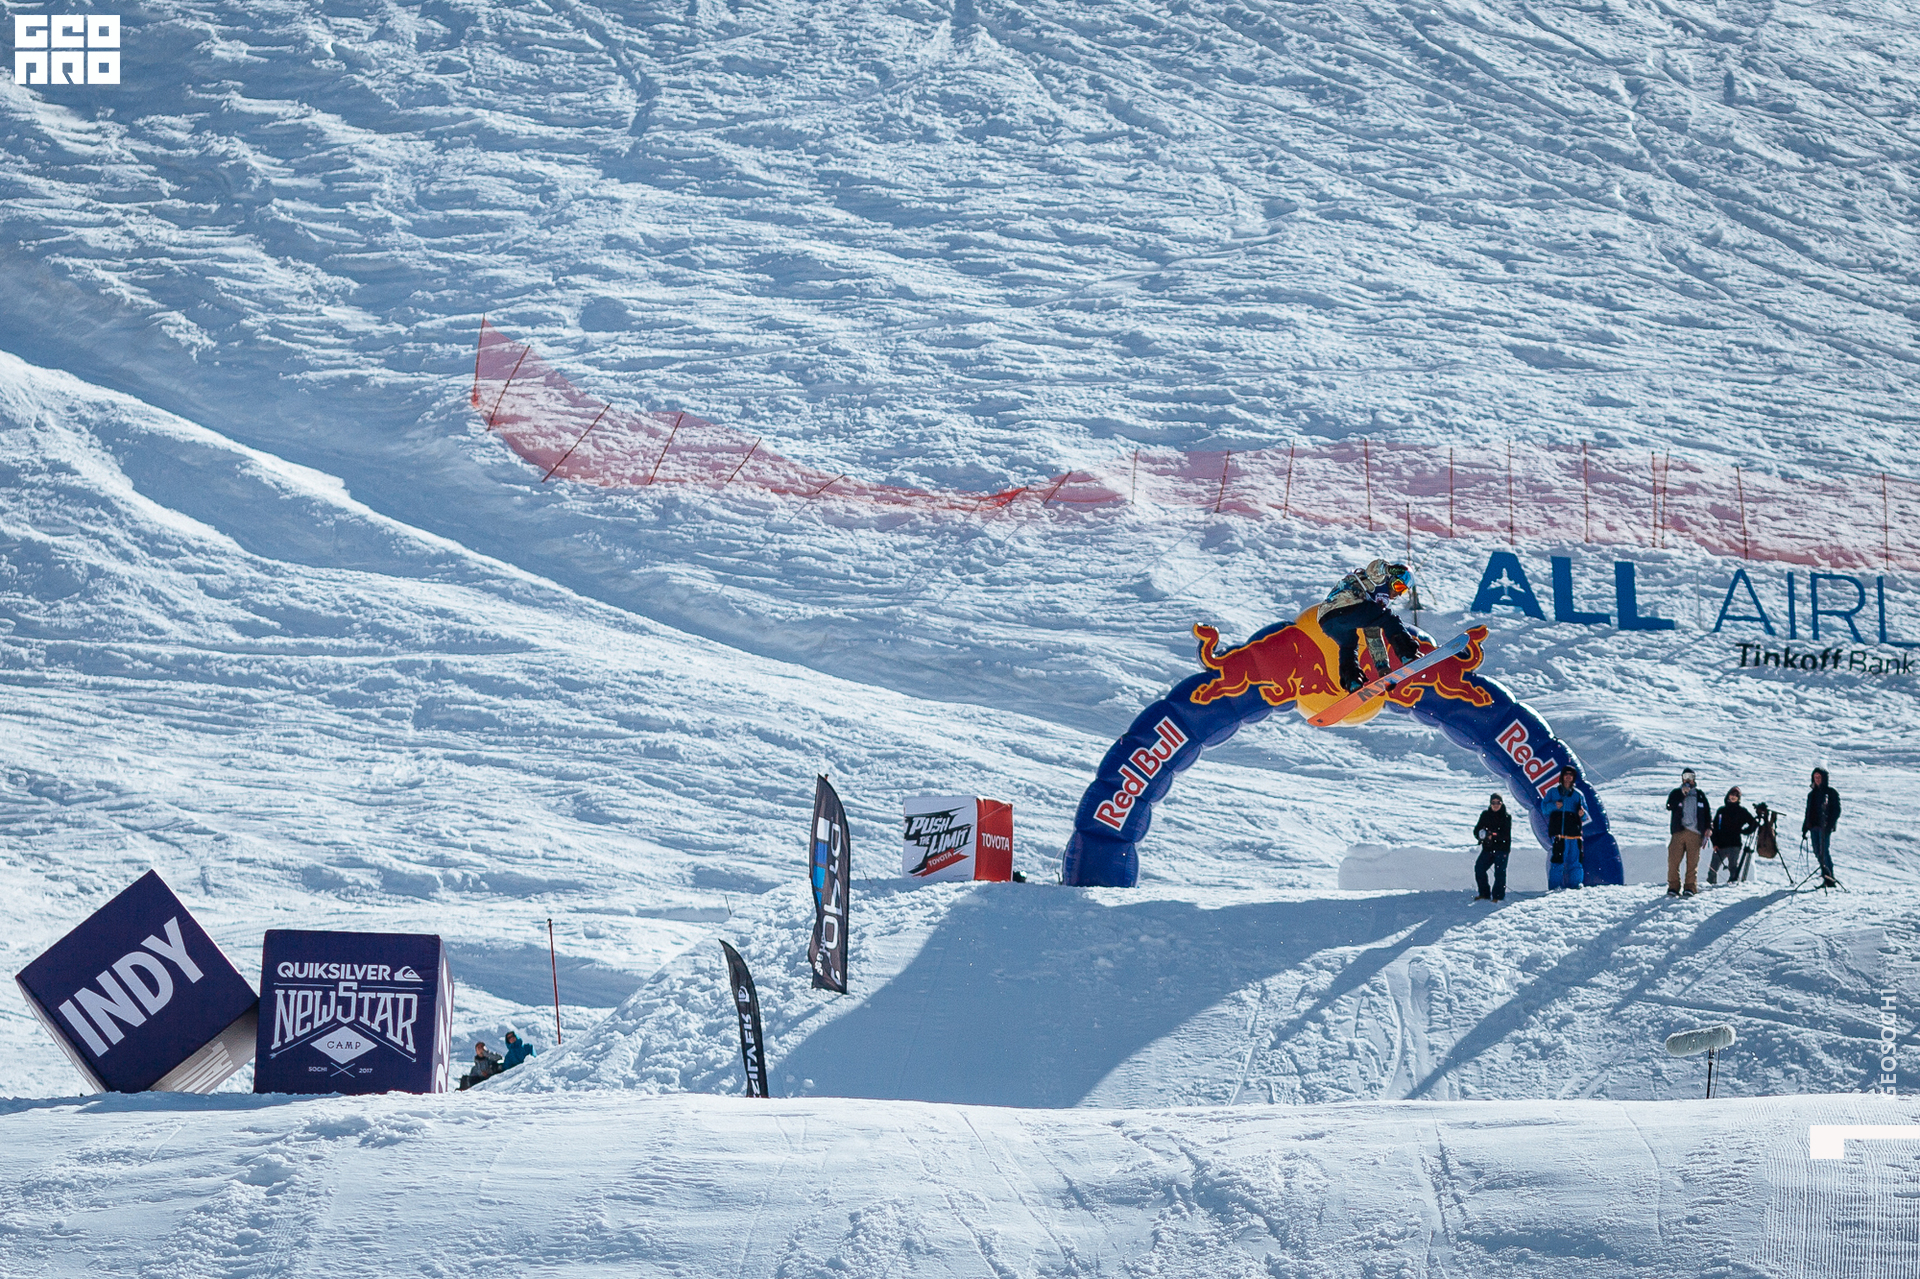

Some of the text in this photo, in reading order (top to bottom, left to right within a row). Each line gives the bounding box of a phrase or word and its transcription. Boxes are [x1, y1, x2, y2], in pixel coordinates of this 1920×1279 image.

[1470, 551, 1920, 647] ALL AIRL
[1735, 643, 1916, 675] Tinkoff Bank
[1497, 720, 1557, 782] Red
[1094, 717, 1188, 831] Red Bull
[909, 817, 950, 836] PUSH
[927, 828, 969, 857] LIMIT
[982, 832, 1010, 851] TOYOTA
[928, 852, 953, 867] TOYOTA
[277, 962, 391, 981] QUIKSILVER
[58, 916, 204, 1057] INDY
[326, 1041, 362, 1050] CAMP
